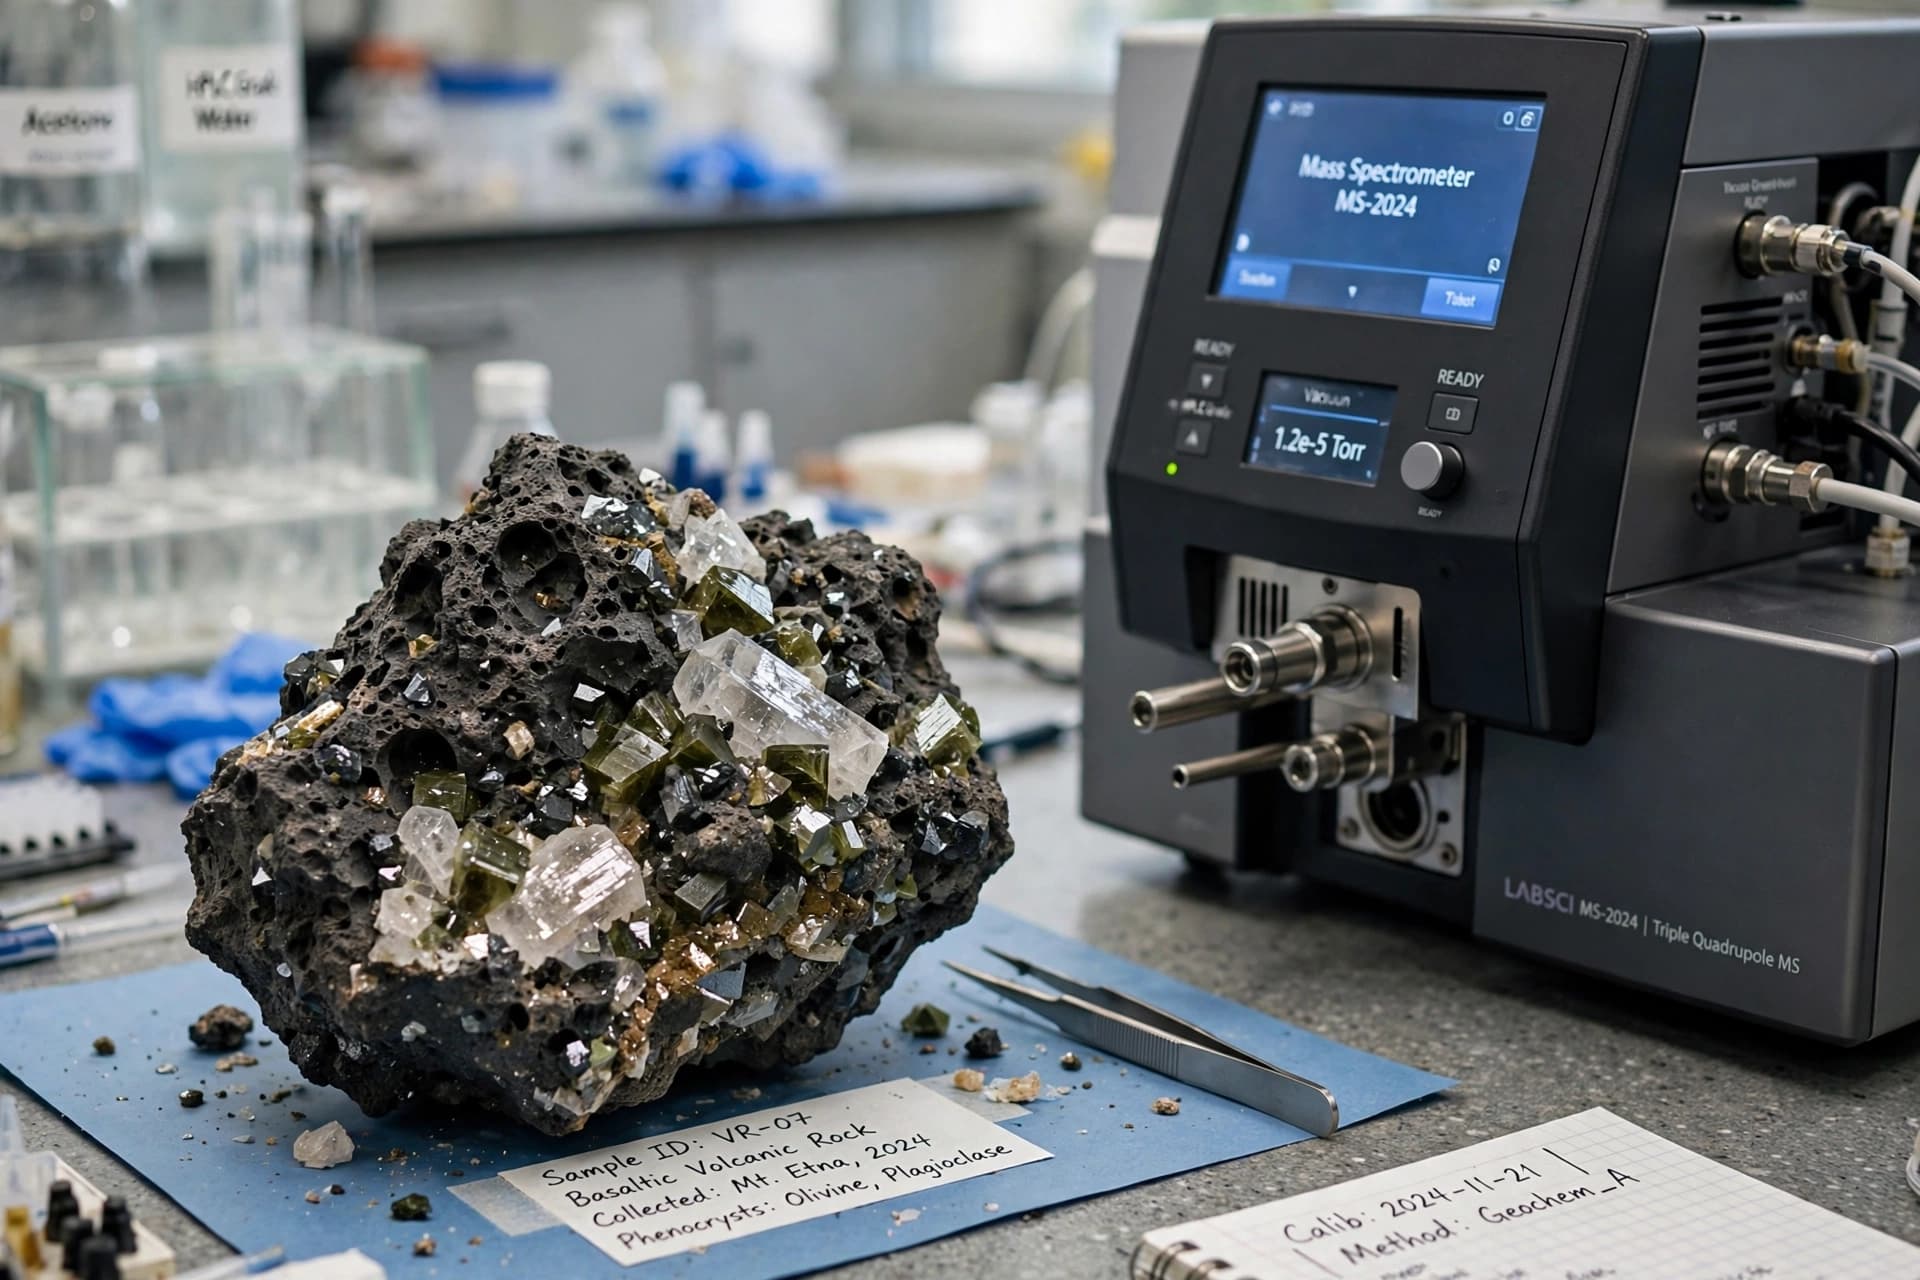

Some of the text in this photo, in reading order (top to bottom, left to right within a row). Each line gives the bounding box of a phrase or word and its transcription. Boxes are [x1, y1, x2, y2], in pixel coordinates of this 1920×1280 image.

[1299, 153, 1475, 188] Mass Spectrometer
[1334, 188, 1418, 218] MS-2024
[1193, 338, 1235, 359] READY
[1437, 368, 1485, 390] READY
[1274, 426, 1366, 462] 1.2e-5 Torr
[1504, 876, 1574, 914] LABSCI
[1579, 899, 1639, 930] MS-2024
[1652, 919, 1690, 944] Triple
[1692, 930, 1775, 967] Quadrupole
[1778, 954, 1800, 975] MS
[542, 1111, 812, 1187] Sample ID: VR-07
[565, 1122, 877, 1208] Basaltic Volcanic Rock
[593, 1133, 931, 1228] Collected: Mt. Etna, 2024
[617, 1144, 1013, 1250] Phenocrysts: Olivine, Plagioclase
[1283, 1163, 1542, 1244] Calib: 2024-11-21
[1340, 1166, 1641, 1265] Method: Geochem_A
